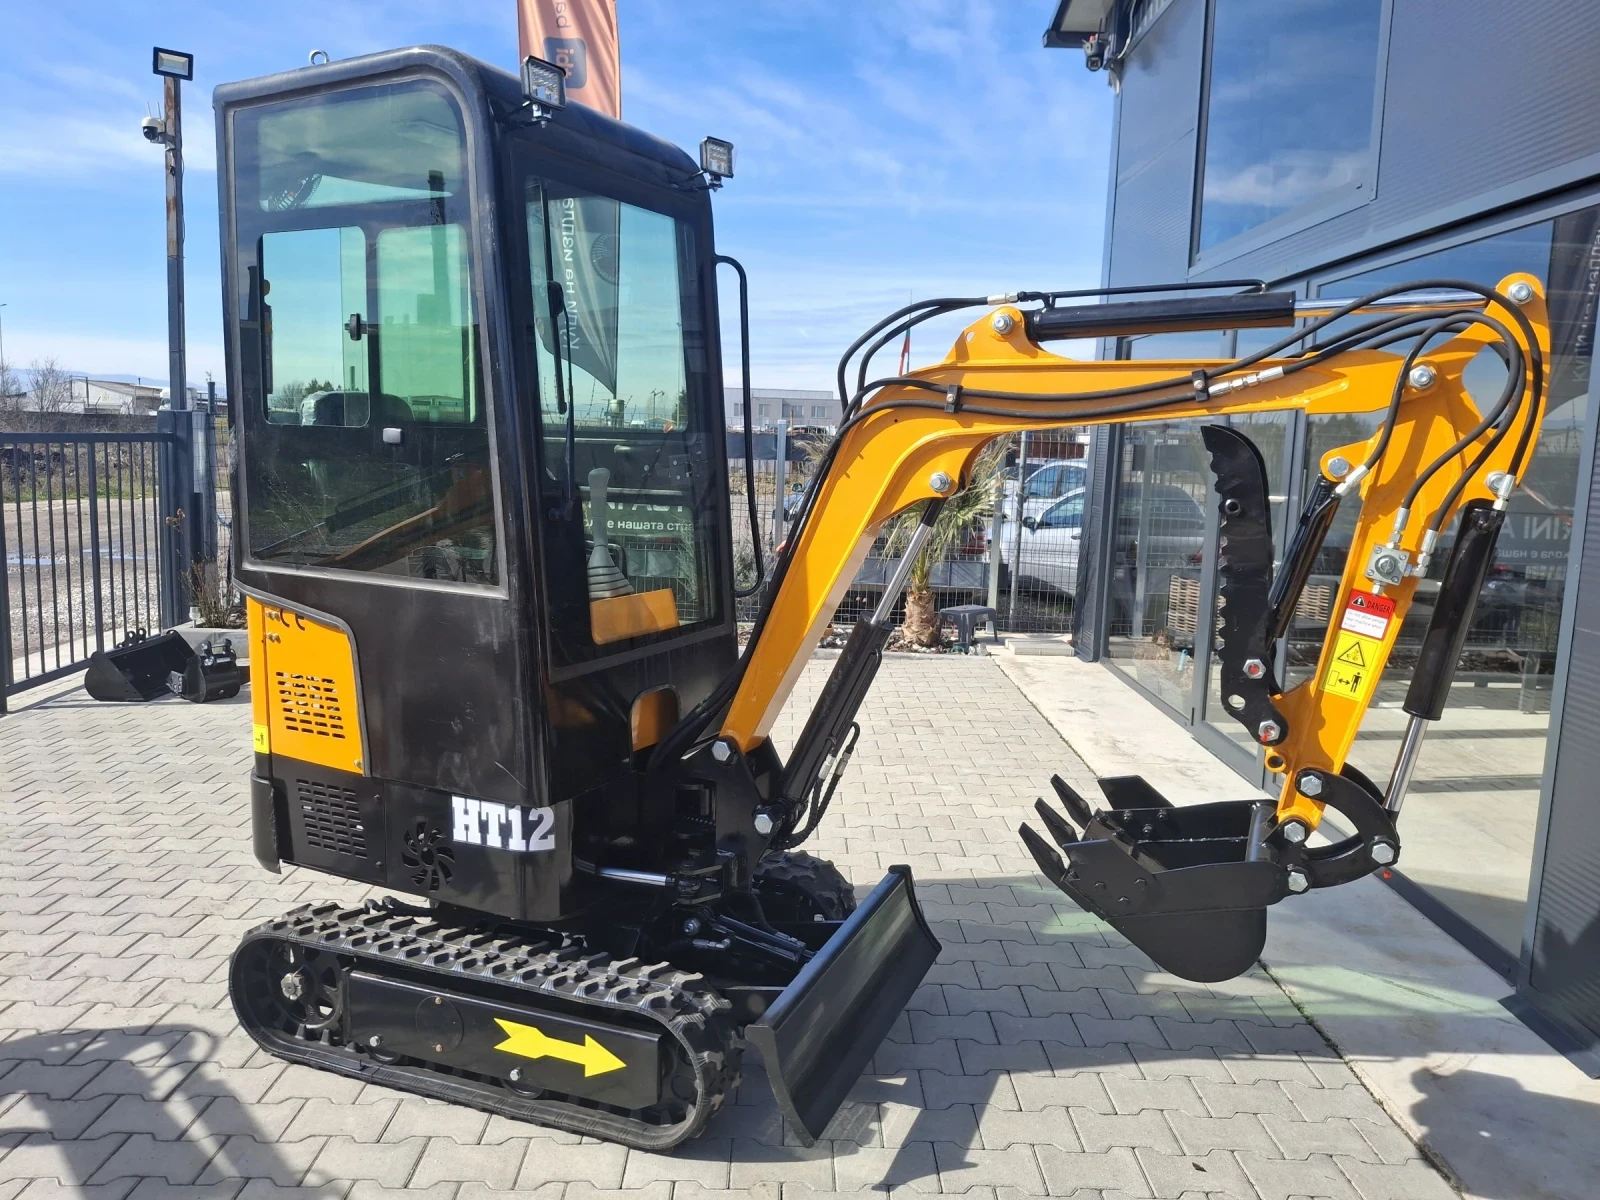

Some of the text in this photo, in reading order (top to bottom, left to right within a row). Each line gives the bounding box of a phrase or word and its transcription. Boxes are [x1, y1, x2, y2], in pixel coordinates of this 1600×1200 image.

[607, 519, 614, 529] е
[617, 520, 664, 531] нашата
[1366, 600, 1391, 614] DANGER
[451, 795, 555, 852] HT12
